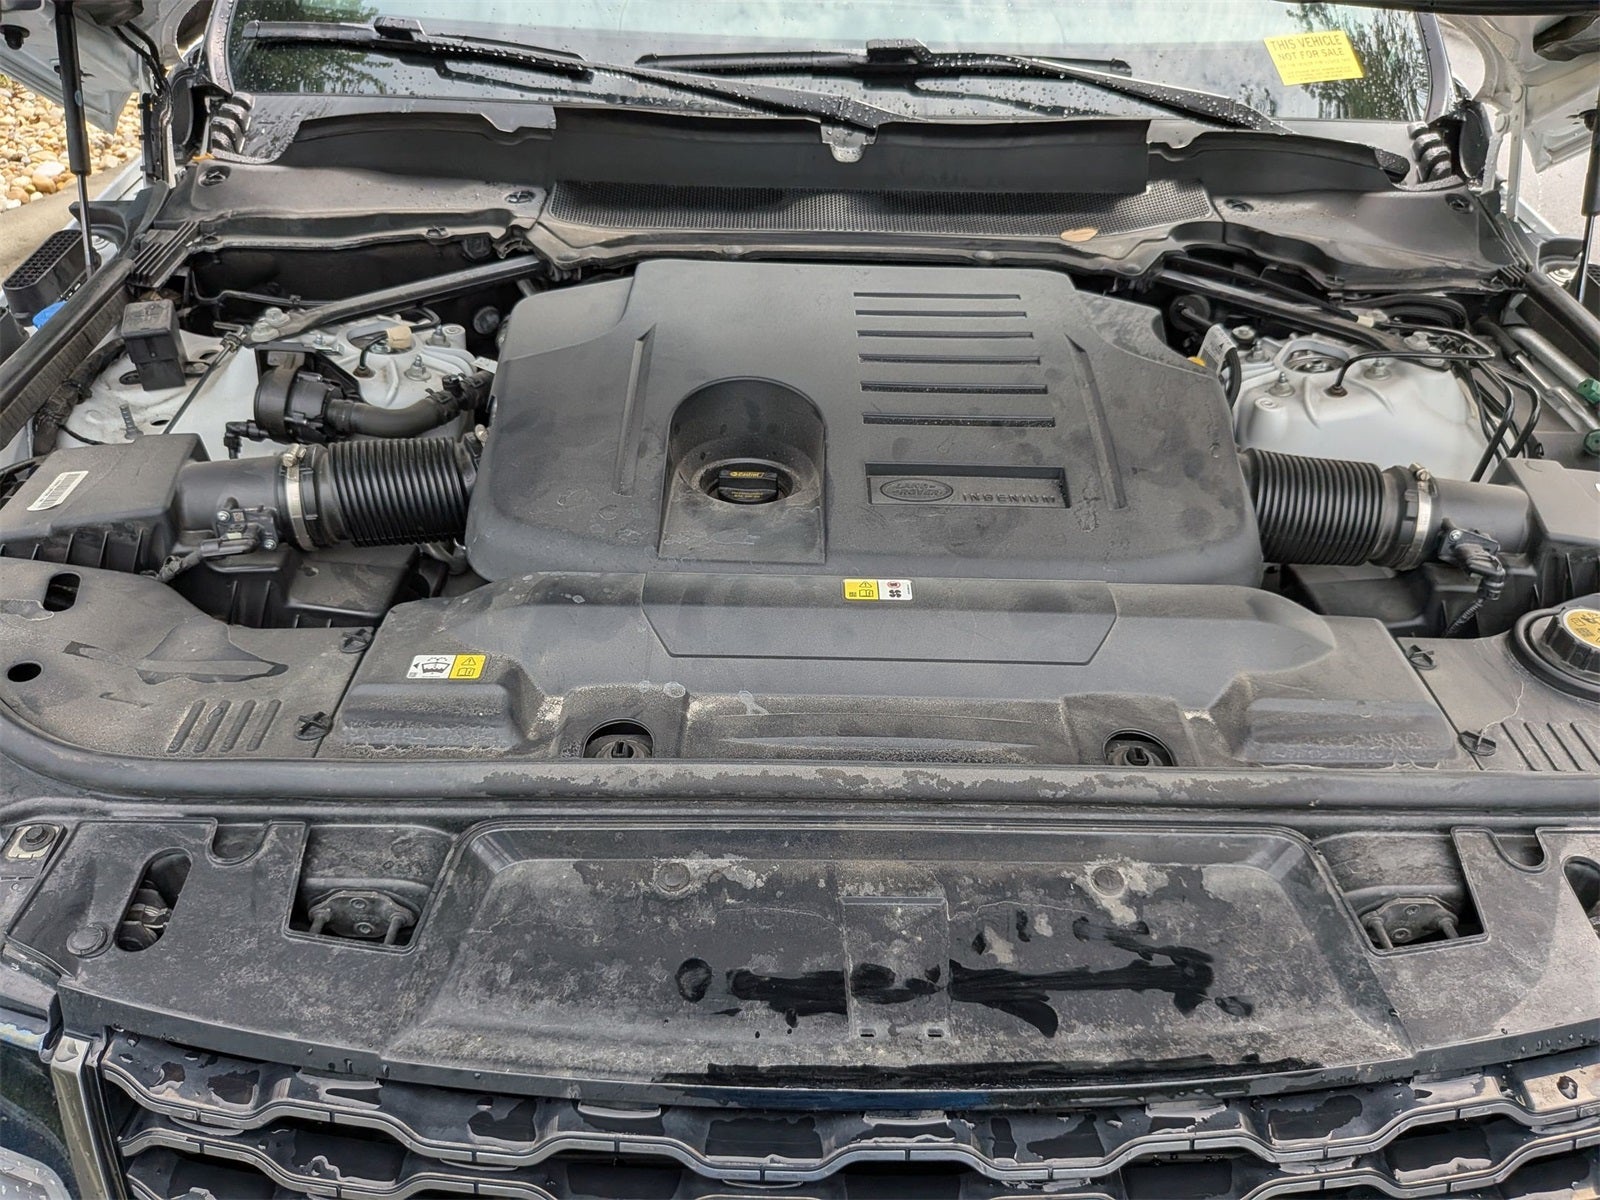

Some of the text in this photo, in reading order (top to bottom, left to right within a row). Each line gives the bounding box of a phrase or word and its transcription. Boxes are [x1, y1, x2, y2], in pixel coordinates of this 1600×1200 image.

[1270, 34, 1343, 51] THIS VEHICLE
[1278, 47, 1344, 61] NOT FOR SALE
